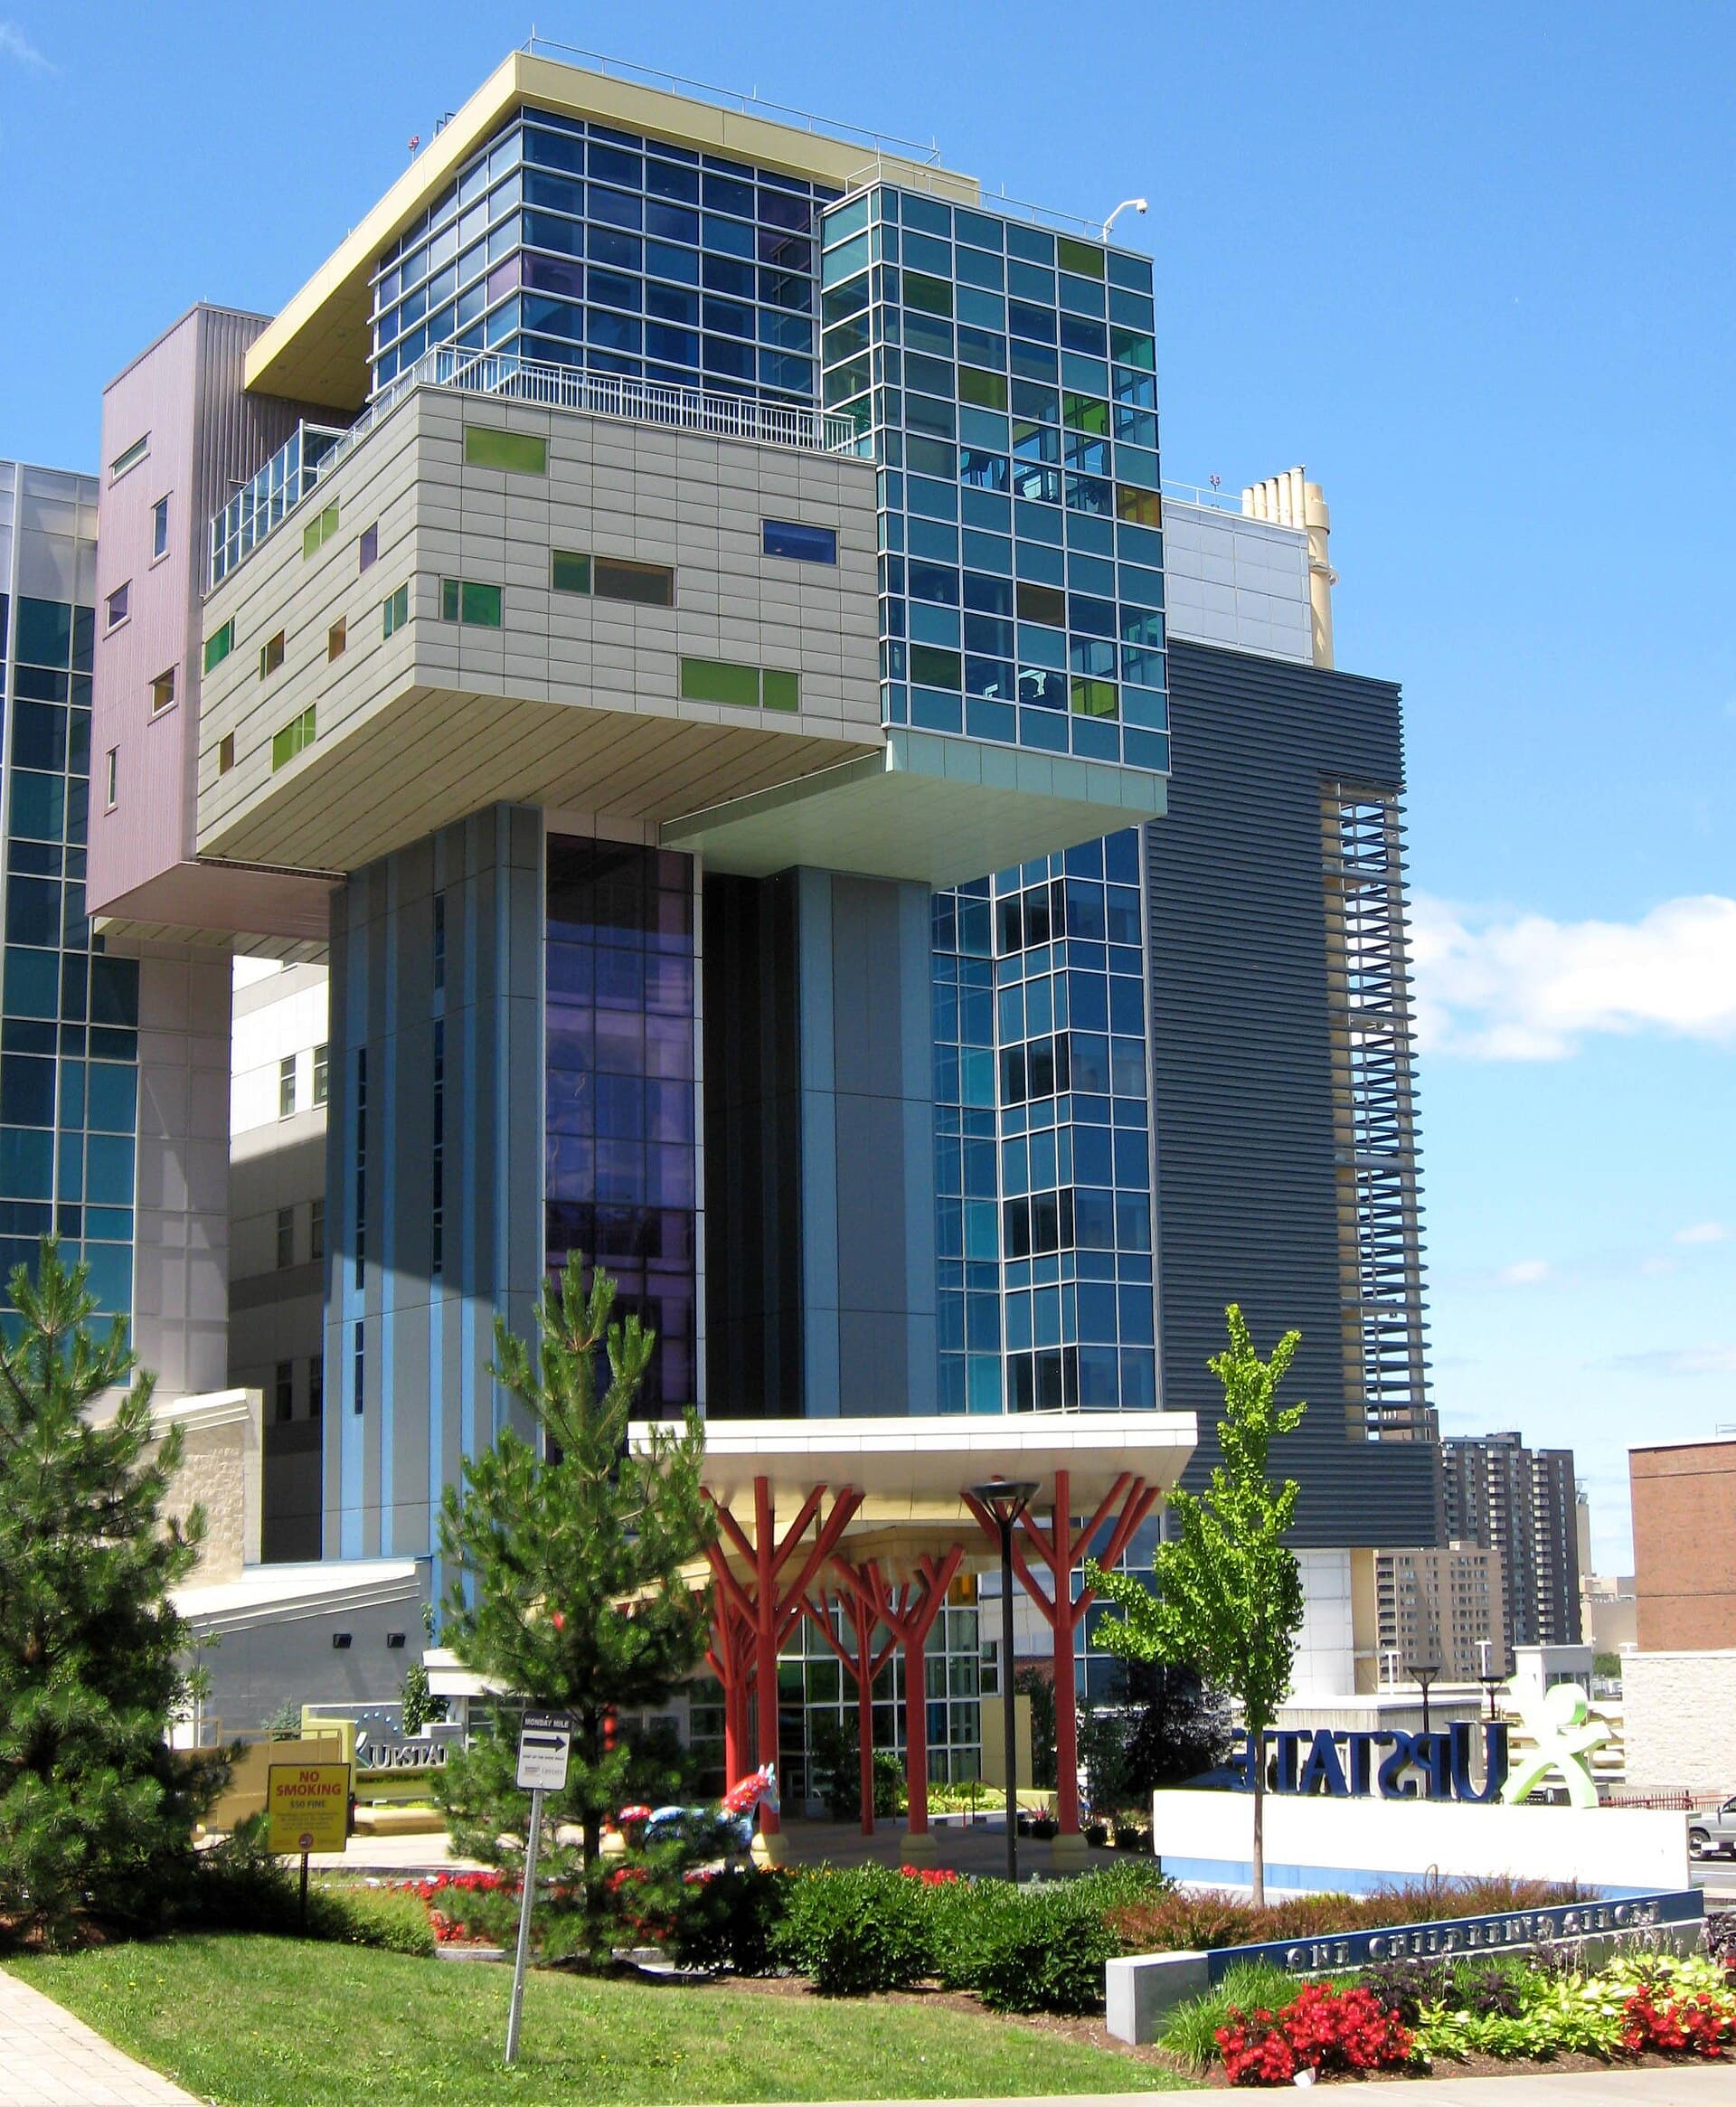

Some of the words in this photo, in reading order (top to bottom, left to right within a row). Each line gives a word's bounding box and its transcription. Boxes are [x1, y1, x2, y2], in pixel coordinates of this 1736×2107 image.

[524, 1718, 552, 1727] MONDAY
[553, 1720, 570, 1729] MILE
[299, 1772, 320, 1783] NO
[276, 1784, 342, 1797] SMOKING
[290, 1800, 306, 1809] $50
[307, 1800, 326, 1809] FINE
[1285, 1942, 1349, 1970] ONE
